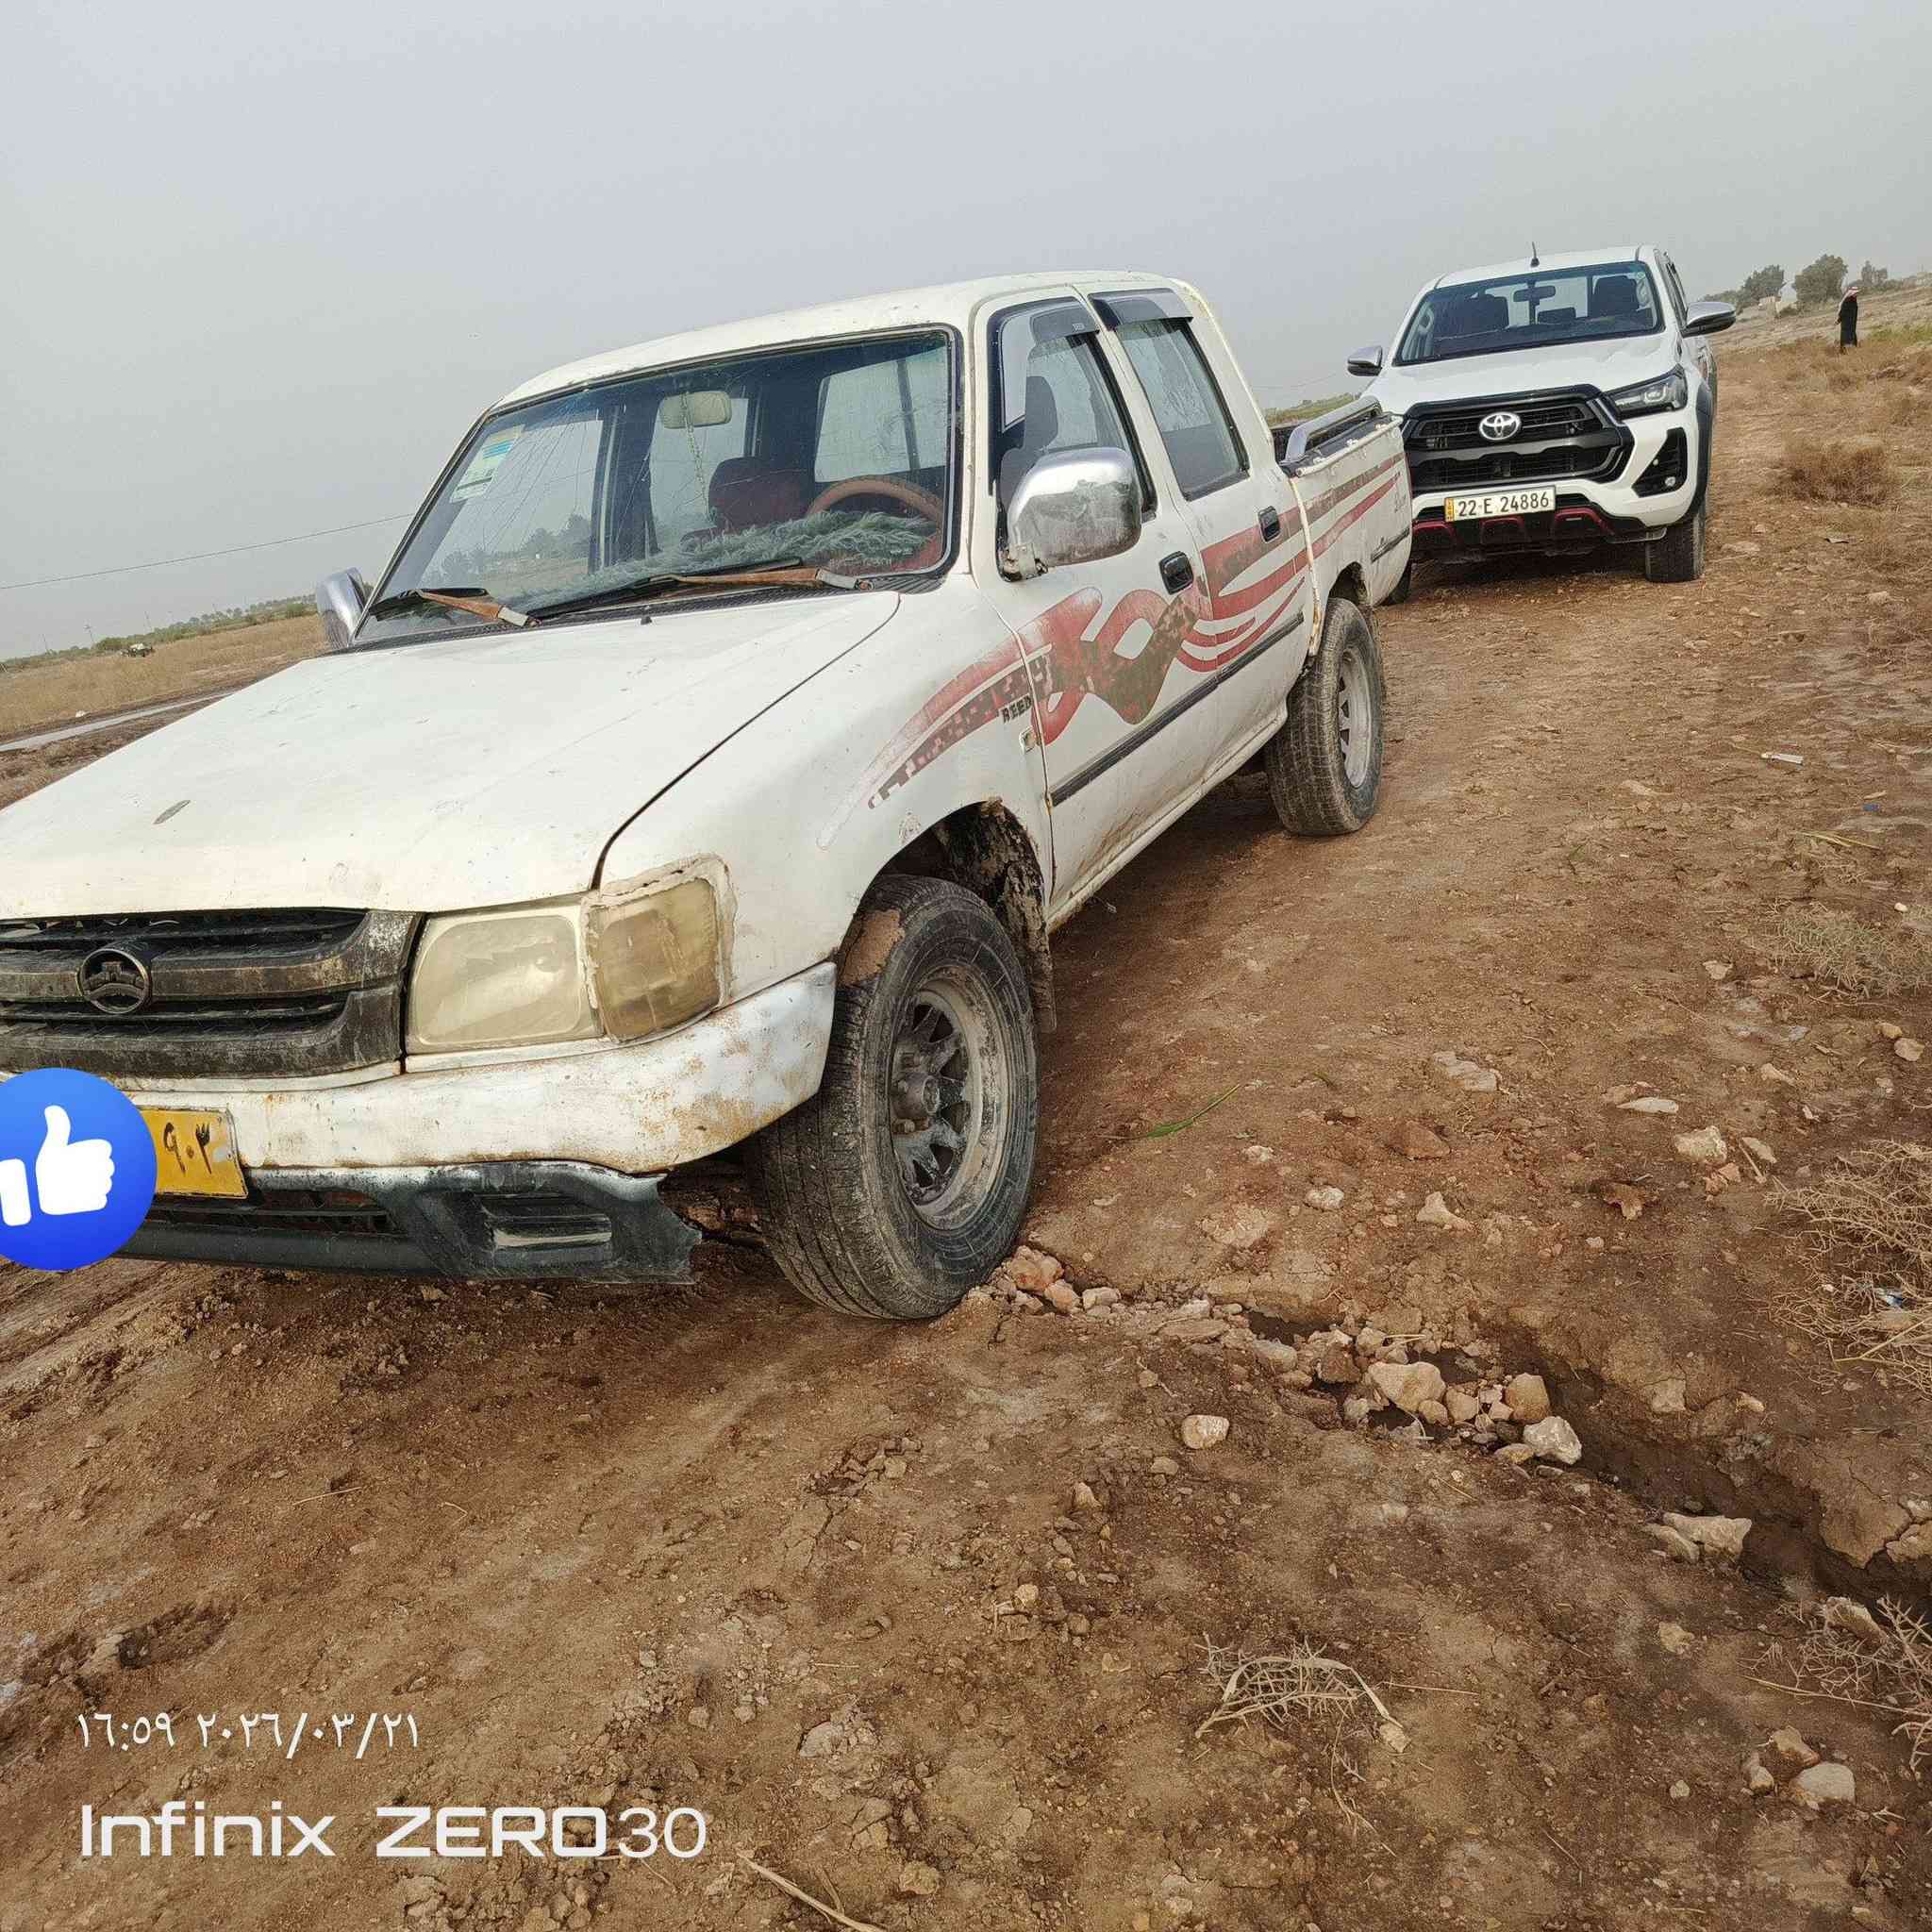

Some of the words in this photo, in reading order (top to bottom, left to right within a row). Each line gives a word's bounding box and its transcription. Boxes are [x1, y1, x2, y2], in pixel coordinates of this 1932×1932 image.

[1457, 499, 1477, 517] 22
[1483, 497, 1492, 514] E
[1500, 491, 1549, 513] 24886
